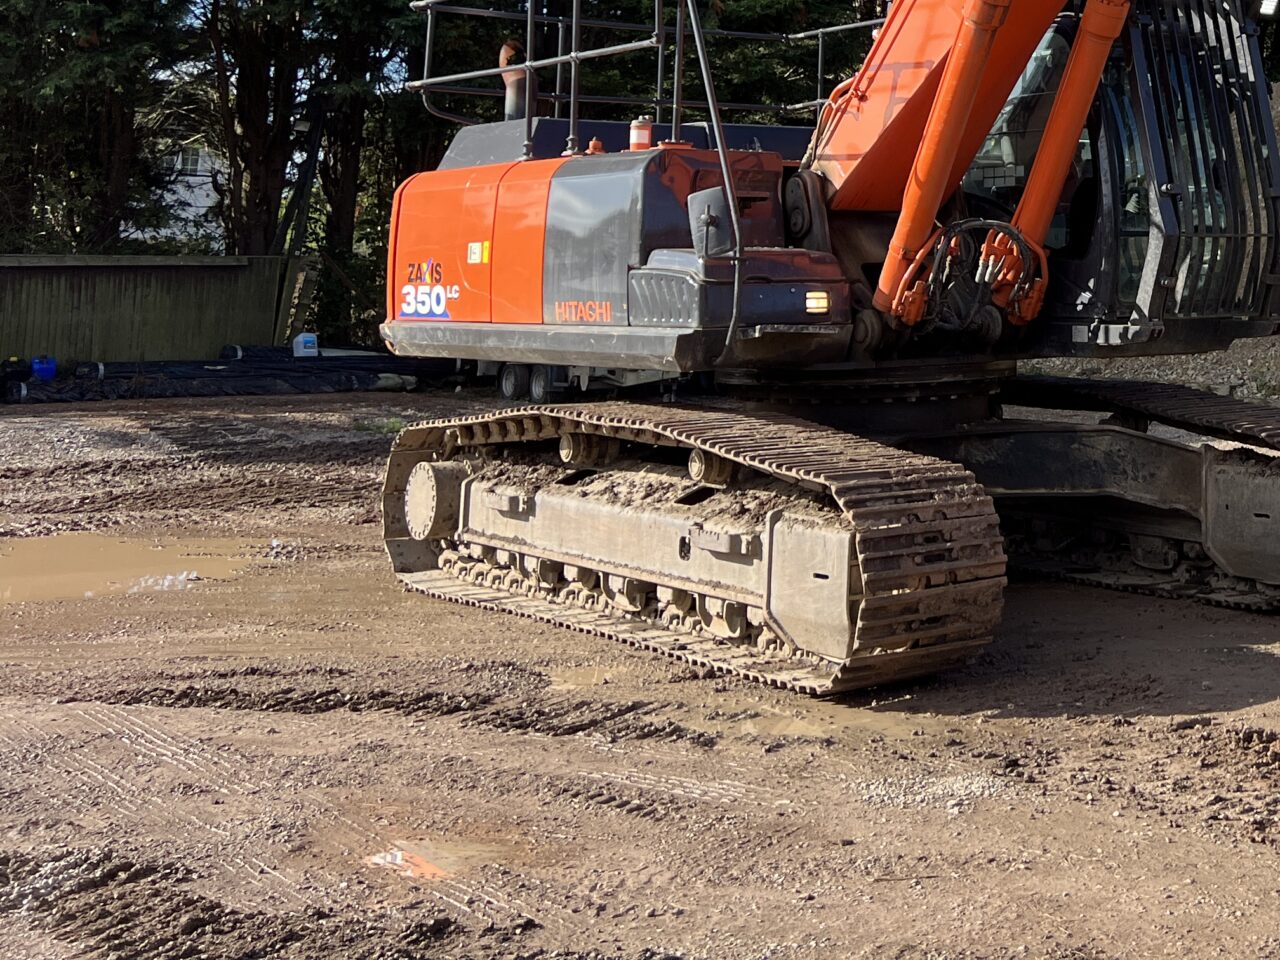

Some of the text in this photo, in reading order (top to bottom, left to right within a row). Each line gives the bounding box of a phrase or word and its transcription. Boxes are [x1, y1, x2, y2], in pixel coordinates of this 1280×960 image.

[407, 257, 442, 284] ZAXIS
[401, 285, 460, 315] 350 LC
[555, 300, 612, 322] HITACHI
